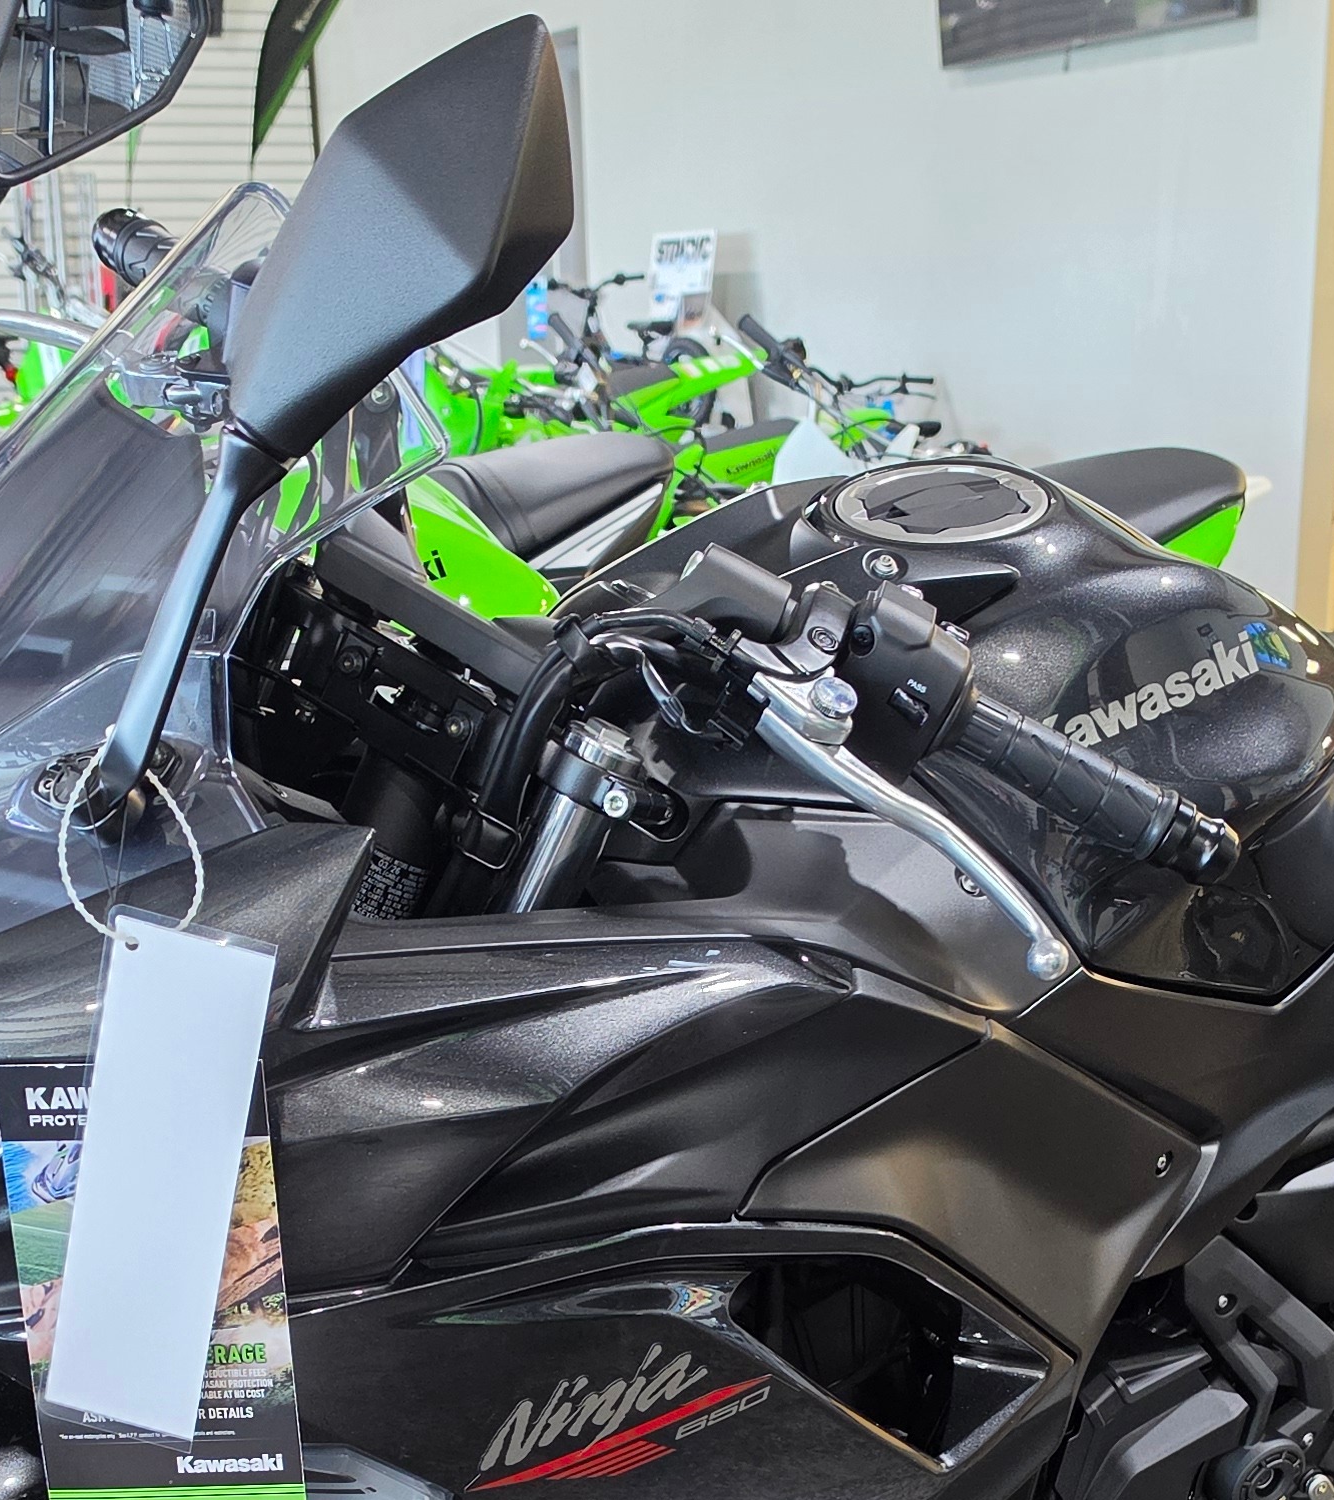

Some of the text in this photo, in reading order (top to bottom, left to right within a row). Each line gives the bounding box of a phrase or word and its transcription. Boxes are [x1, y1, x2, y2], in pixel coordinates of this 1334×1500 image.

[907, 679, 927, 693] PASS
[1043, 630, 1259, 748] awasaki
[248, 1367, 268, 1377] FEES
[228, 1378, 274, 1389] PROTECTION
[223, 1390, 234, 1399] AT
[246, 1388, 266, 1398] COST
[208, 1406, 255, 1419] DETAILS
[477, 1343, 771, 1472] Ninja 650
[176, 1453, 284, 1474] Kawasaki
